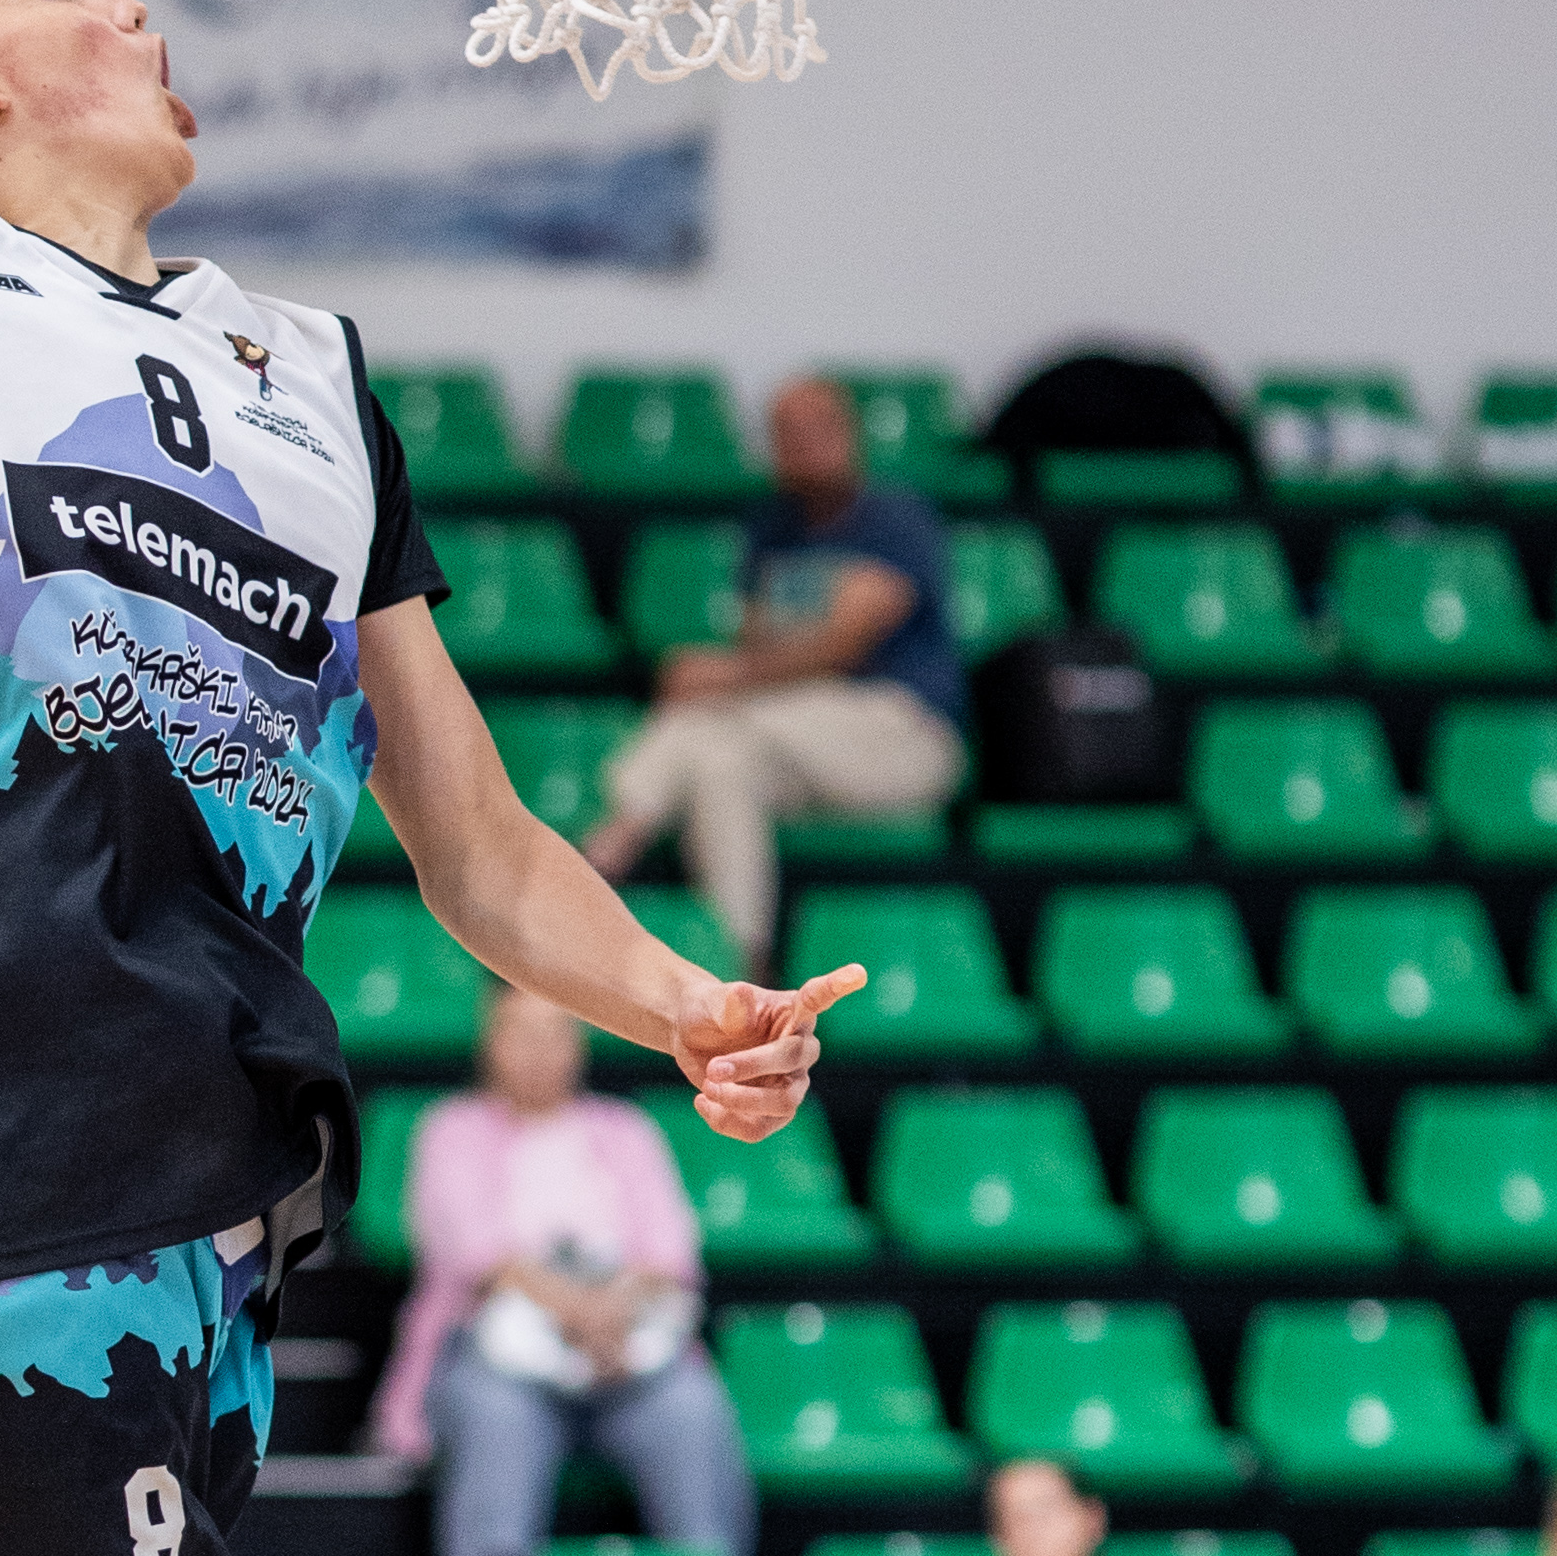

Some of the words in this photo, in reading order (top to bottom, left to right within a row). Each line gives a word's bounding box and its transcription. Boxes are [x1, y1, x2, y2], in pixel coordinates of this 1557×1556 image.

[135, 353, 212, 473] 8
[49, 495, 312, 641] telemach
[248, 747, 314, 834] 2024
